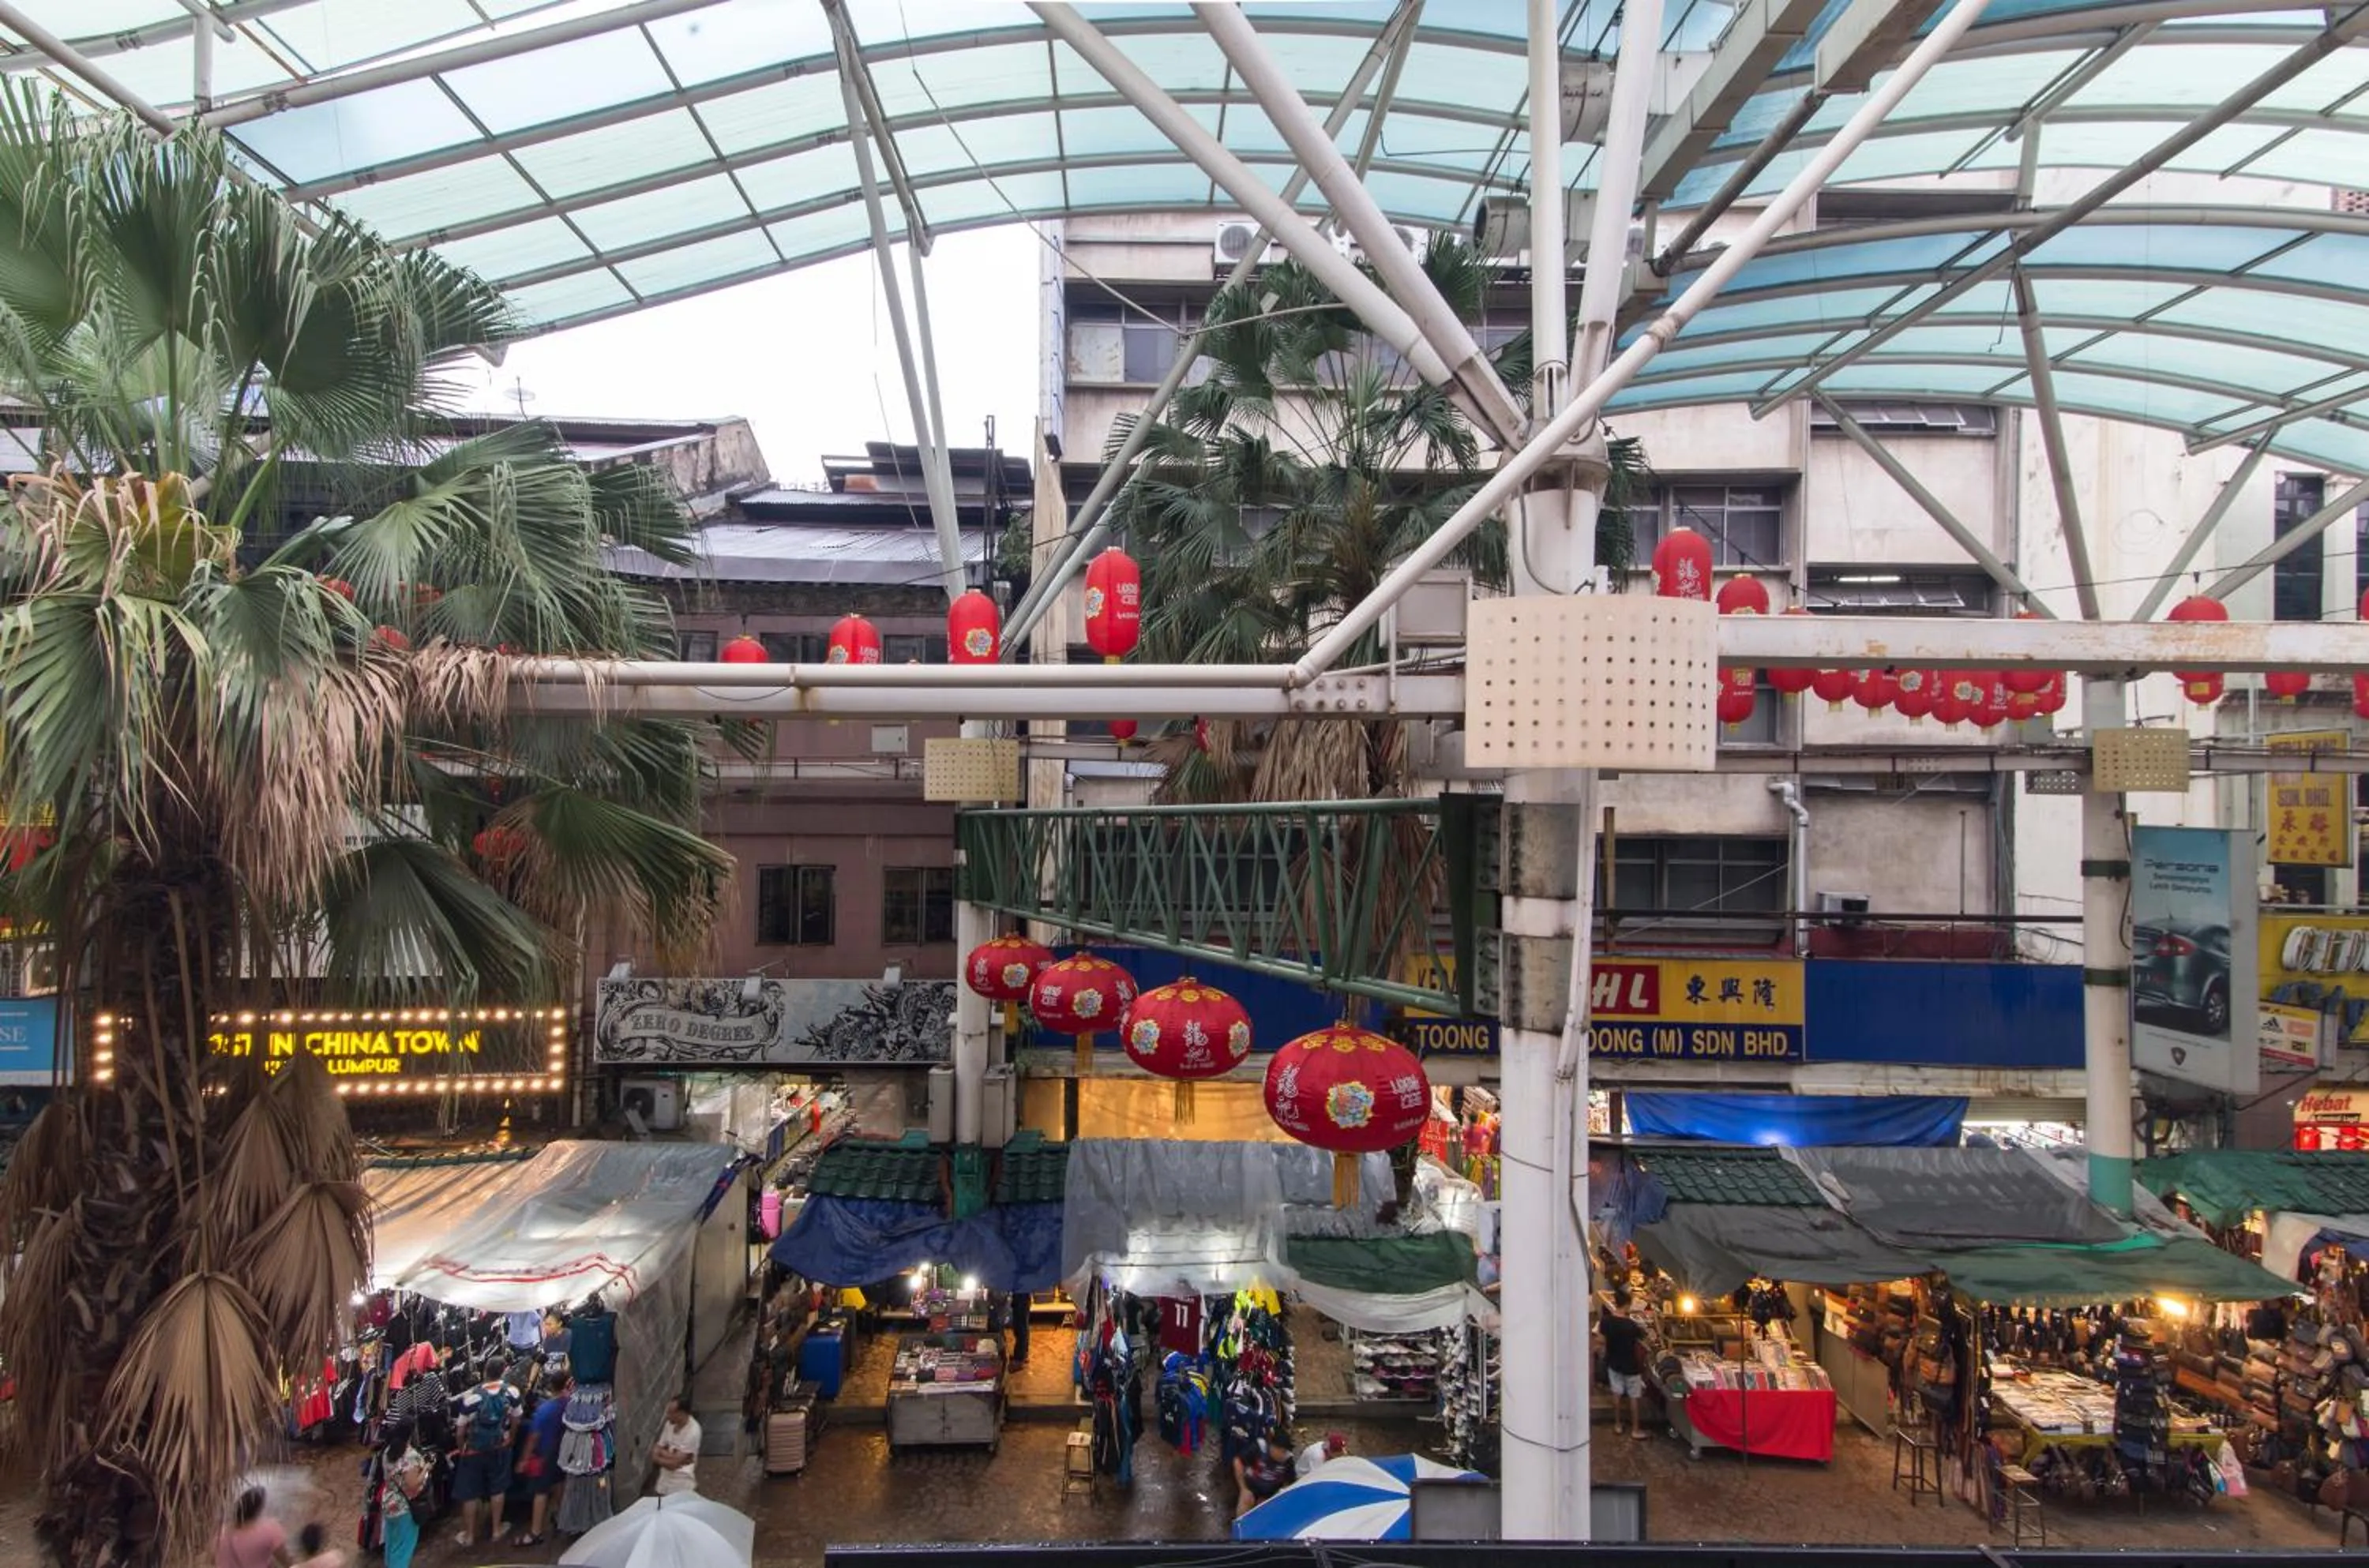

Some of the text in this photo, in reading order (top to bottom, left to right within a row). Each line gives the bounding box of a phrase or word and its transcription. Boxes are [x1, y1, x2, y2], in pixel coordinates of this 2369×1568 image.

[1686, 973, 1775, 1011] 東興隆
[632, 1015, 756, 1041] ZERO DEGREE
[1416, 1024, 1490, 1049] TOONG
[306, 1032, 390, 1056] CHINA
[394, 1030, 481, 1055] TOWN
[1652, 1027, 1684, 1054] (M)
[1692, 1030, 1736, 1056] SDN
[1744, 1031, 1788, 1056] BHD
[327, 1059, 401, 1075] LUMPUR
[2300, 1094, 2352, 1112] Hebat
[1174, 1303, 1188, 1329] 11
